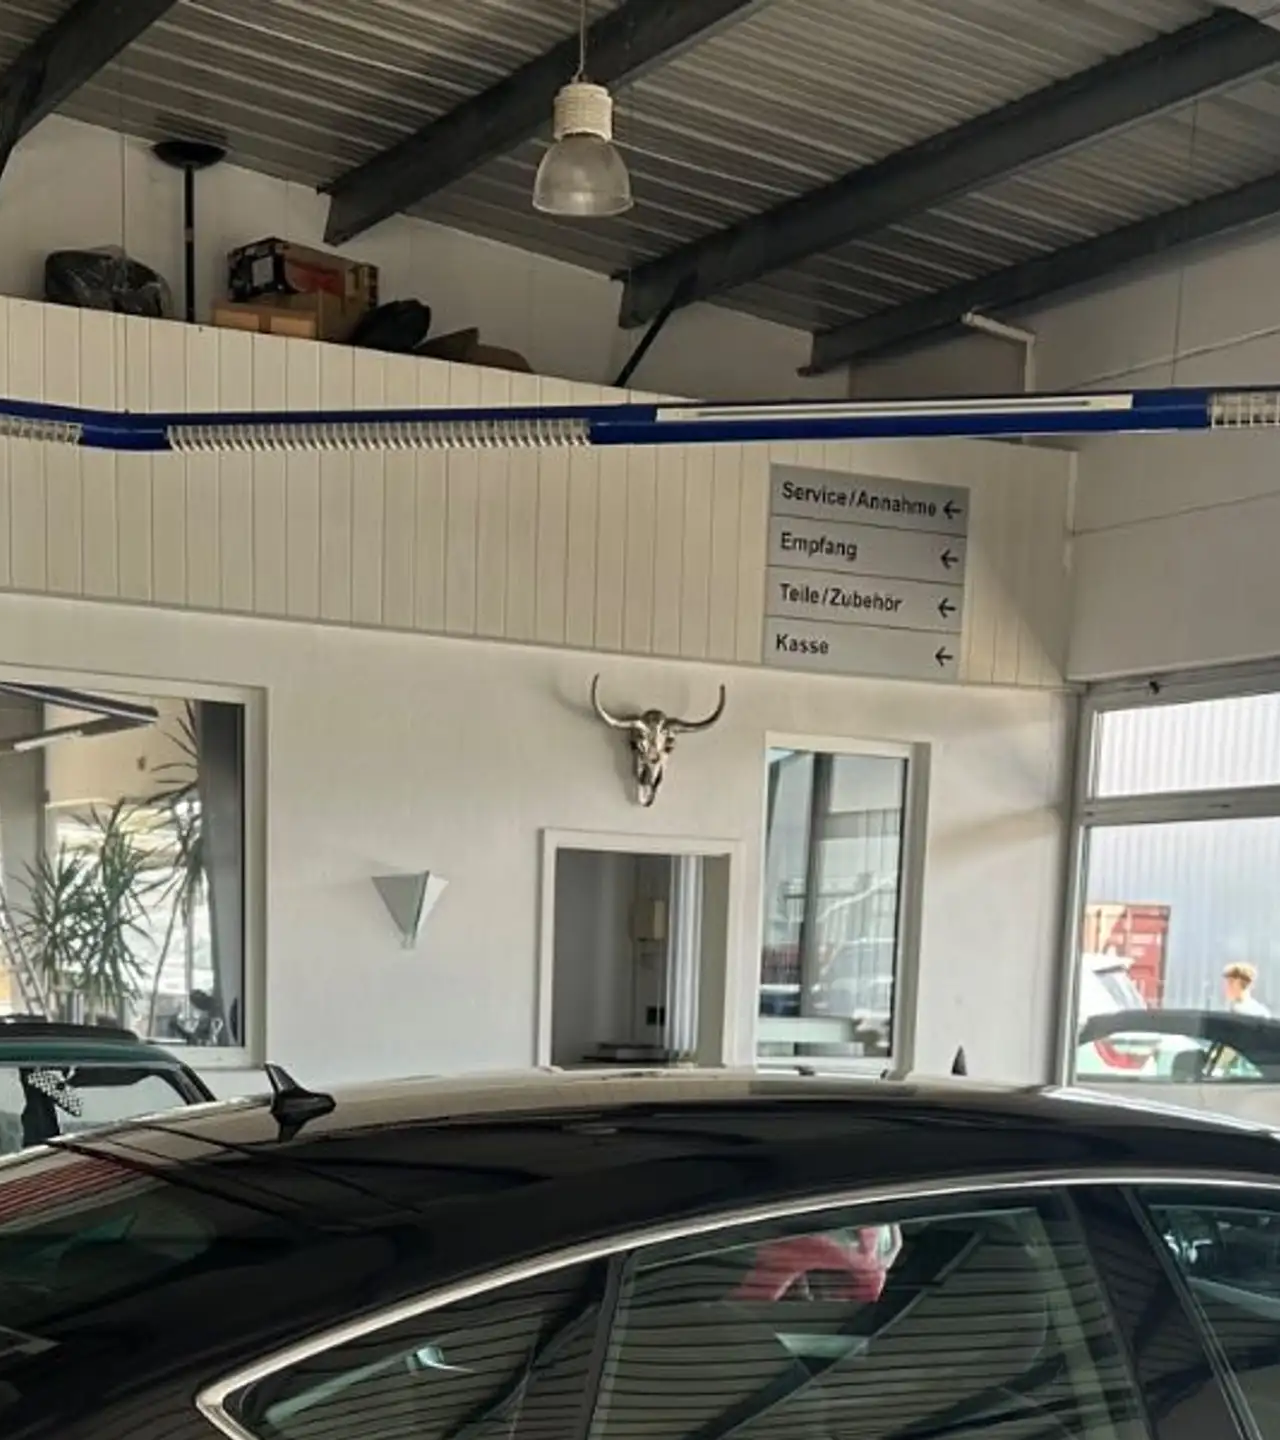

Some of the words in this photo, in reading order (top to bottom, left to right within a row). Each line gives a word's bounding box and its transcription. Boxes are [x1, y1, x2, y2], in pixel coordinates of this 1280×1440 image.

[781, 481, 937, 516] Service/Annahme
[780, 531, 858, 562] Empfang
[775, 633, 830, 655] Kasse
